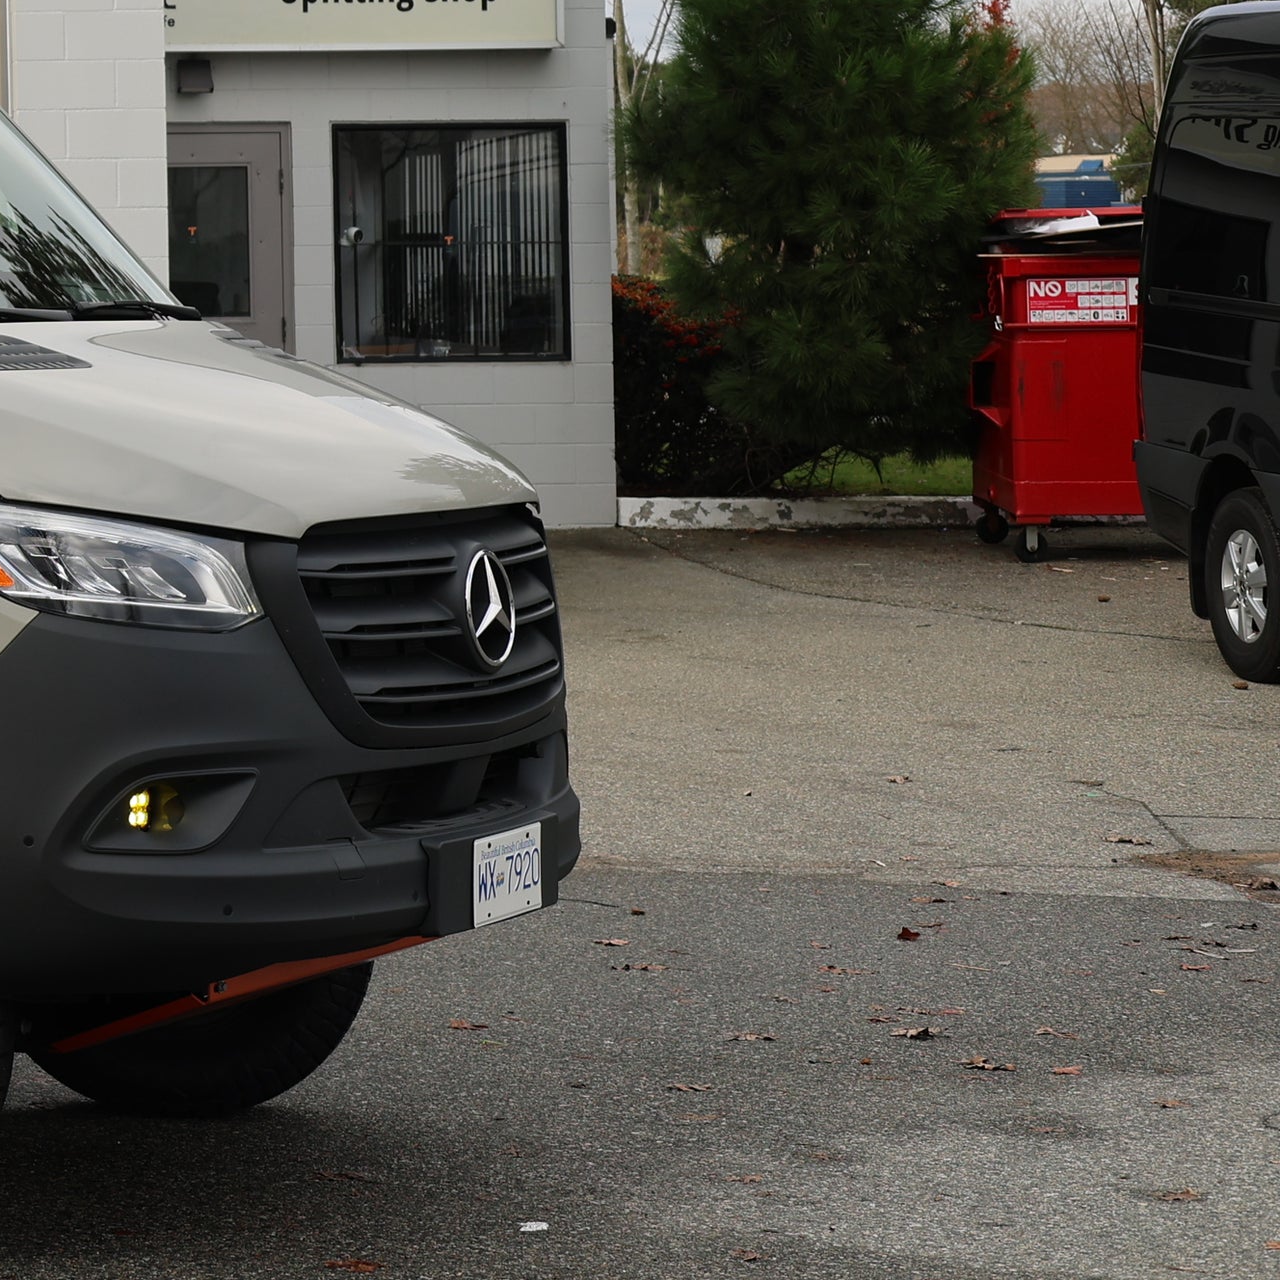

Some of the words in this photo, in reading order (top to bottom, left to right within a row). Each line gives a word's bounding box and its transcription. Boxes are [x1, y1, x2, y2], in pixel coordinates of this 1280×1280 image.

[1030, 281, 1062, 297] NO
[479, 859, 496, 903] WX
[506, 848, 540, 895] 7920
